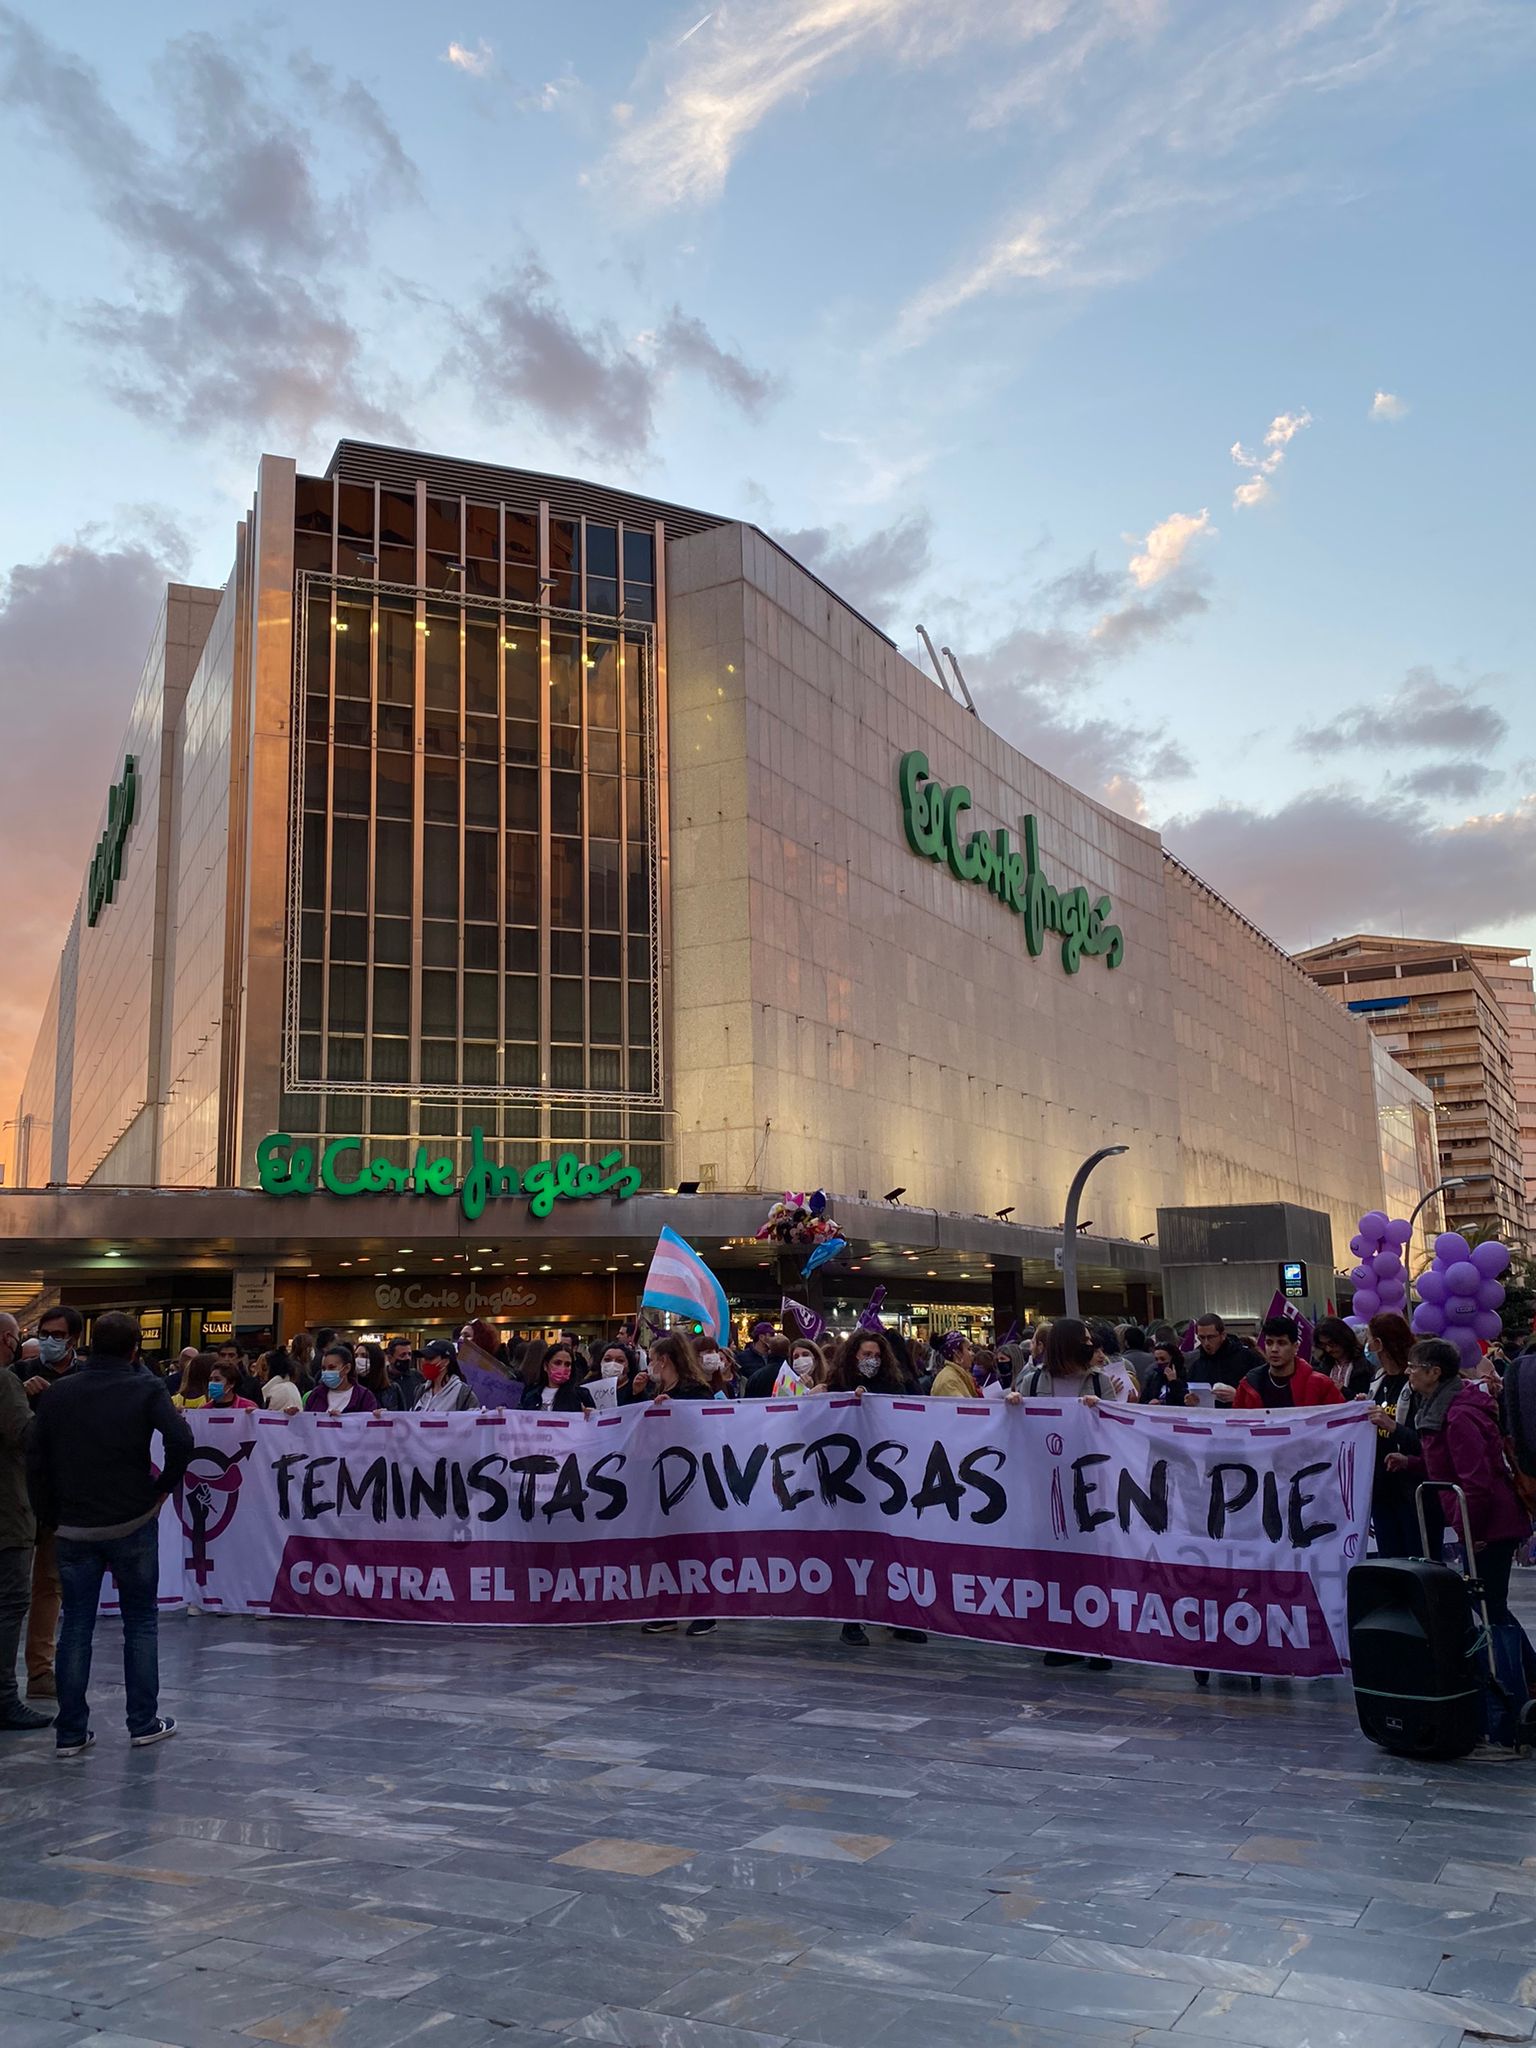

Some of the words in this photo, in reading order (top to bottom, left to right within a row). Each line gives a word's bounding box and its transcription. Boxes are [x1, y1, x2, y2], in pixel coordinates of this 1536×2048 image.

[899, 750, 947, 862] El
[944, 785, 1026, 912] Corte
[1024, 814, 1123, 974] Inglés
[256, 1133, 315, 1195] El
[321, 1137, 454, 1196] Corte
[461, 1125, 641, 1219] Inglés
[375, 1284, 401, 1309] El
[404, 1283, 460, 1308] Corte
[464, 1282, 537, 1314] Inglés
[271, 1452, 628, 1524] FEMINISTAS
[652, 1432, 1007, 1525] DIVERSAS
[290, 1561, 455, 1601] CONTRA
[469, 1567, 516, 1602] EL
[528, 1556, 833, 1603] PATRIARCADO
[844, 1558, 874, 1596] Y
[887, 1562, 937, 1608] SU
[952, 1573, 1311, 1650] EXPLOTACIÓN
